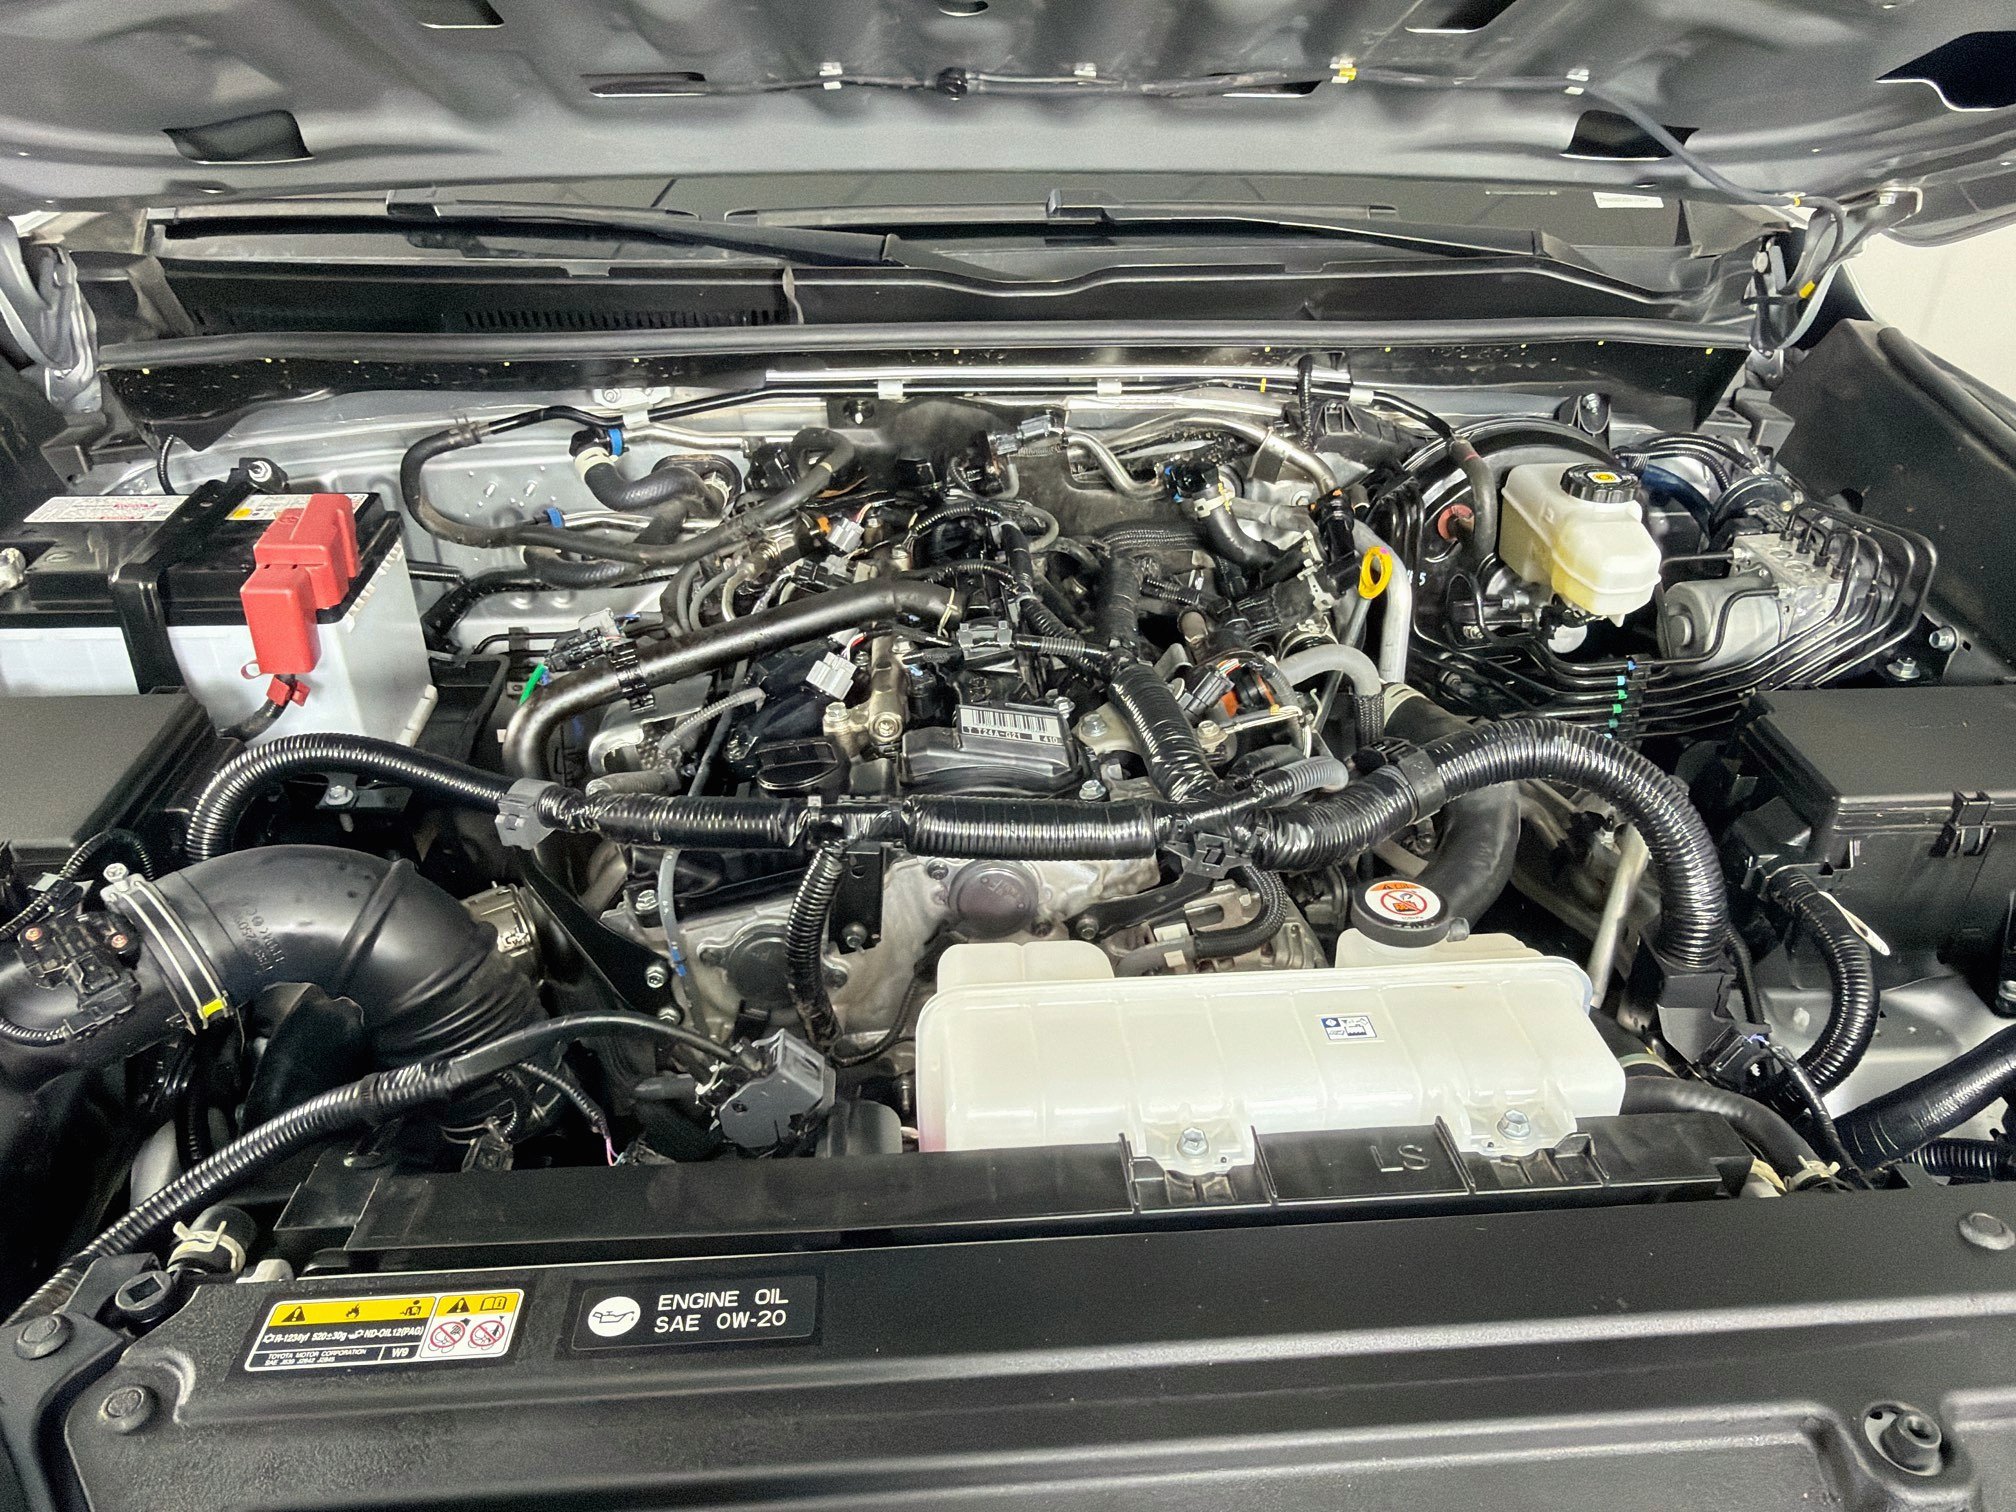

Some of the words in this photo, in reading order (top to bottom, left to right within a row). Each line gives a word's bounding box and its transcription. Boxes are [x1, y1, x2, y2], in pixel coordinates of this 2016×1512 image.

[1370, 1144, 1431, 1173] LS
[657, 1290, 740, 1311] ENGINE
[754, 1288, 789, 1305] OIL
[654, 1314, 702, 1334] SAE
[716, 1310, 787, 1330] 0W-20
[268, 1352, 293, 1360] TOYOTA
[295, 1350, 319, 1359] MOTOR
[320, 1348, 367, 1357] CORPORATION
[391, 1347, 409, 1358] W9
